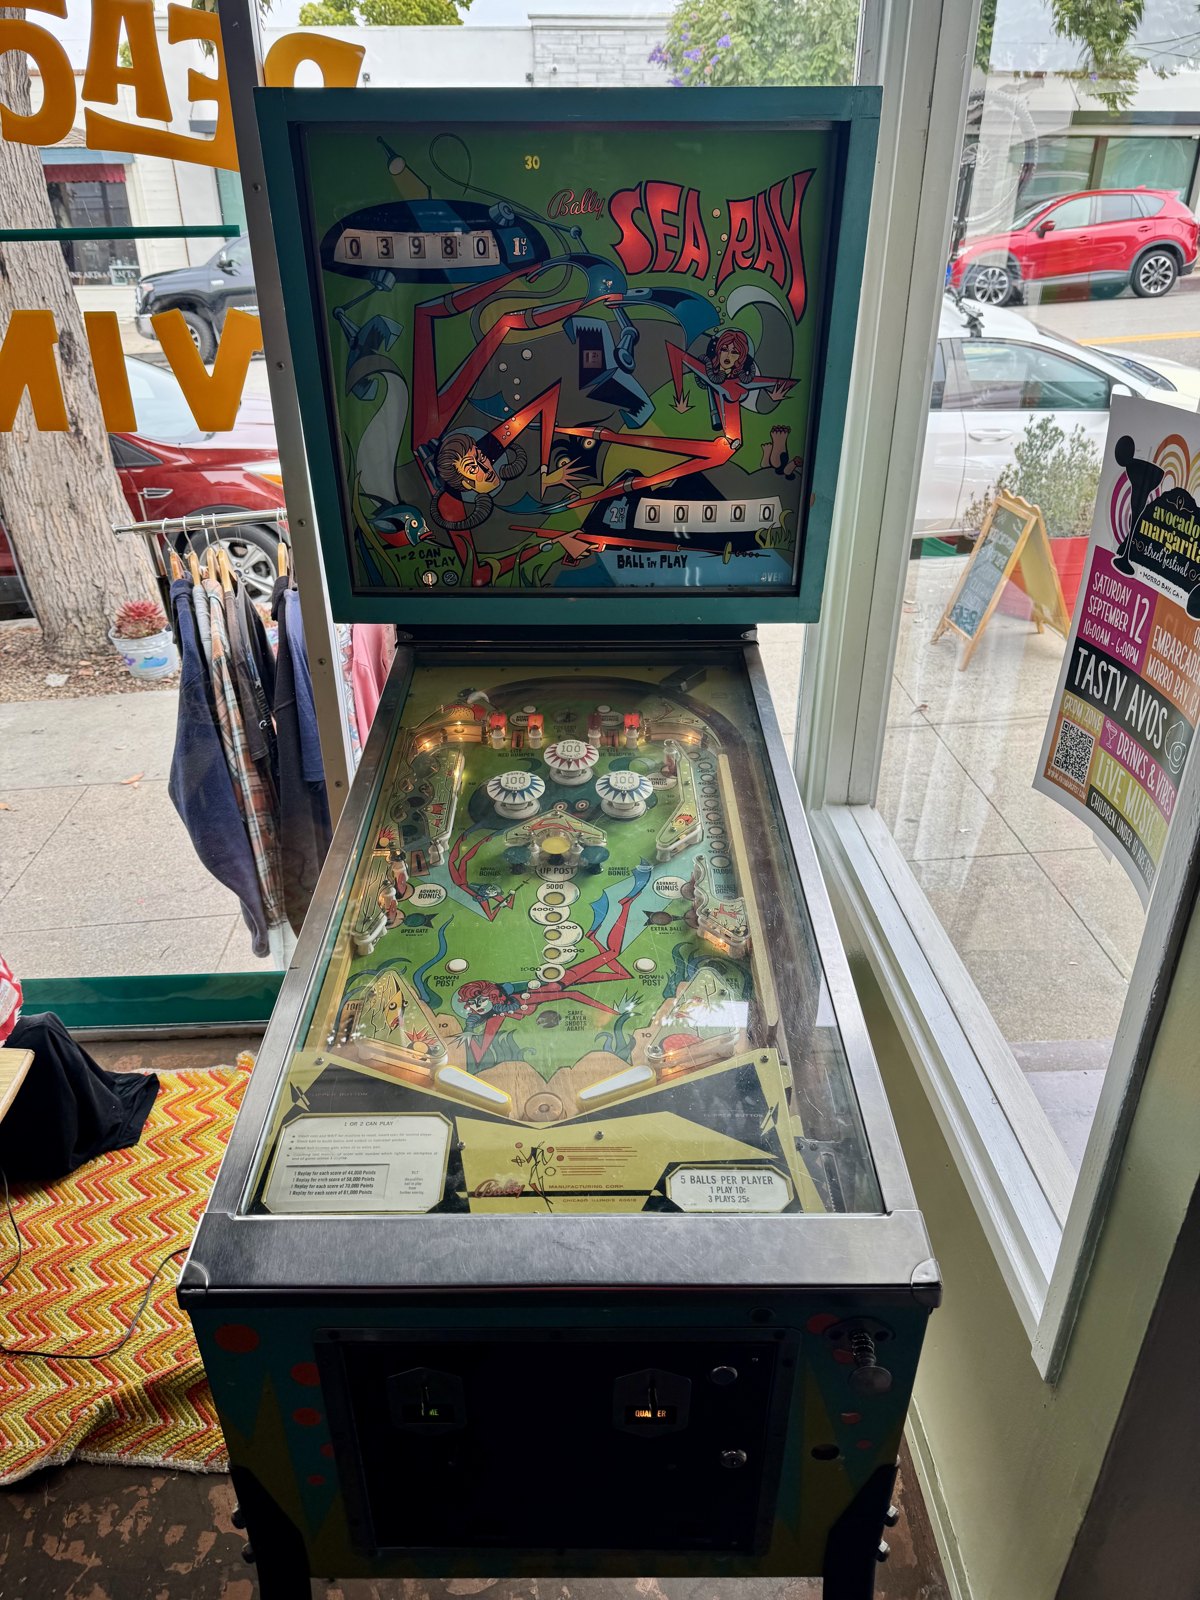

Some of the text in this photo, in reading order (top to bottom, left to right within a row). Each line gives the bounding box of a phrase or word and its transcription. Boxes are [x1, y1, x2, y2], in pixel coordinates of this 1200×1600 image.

[524, 155, 541, 170] 30
[547, 188, 605, 220] Bally
[608, 168, 817, 326] SEA RAY
[418, 548, 441, 559] CAN
[425, 556, 456, 569] PLAY
[617, 554, 644, 569] BALL
[660, 554, 688, 568] PLAY
[1092, 571, 1132, 607] SATURDAY
[1143, 571, 1161, 586] MORRO
[1172, 588, 1180, 597] CA
[1087, 595, 1129, 633] SEPTEMBER
[1129, 594, 1150, 645] 12
[1082, 618, 1110, 647] 10:00AM
[1115, 638, 1140, 666] 6:00PM
[1146, 654, 1174, 692] MORRO
[1173, 675, 1191, 710] BAY,
[1074, 647, 1168, 749] TASTY AVOS
[614, 776, 635, 784] 100
[1147, 764, 1156, 788] &
[1090, 792, 1117, 830] CHILDREN
[1117, 818, 1133, 846] UNDER
[474, 1179, 525, 1199] Bally
[681, 1176, 774, 1184] 5 BALLS PER PLAYER
[708, 1195, 712, 1203] 3
[714, 1195, 736, 1203] PLAYS
[635, 1409, 667, 1418] QUAER
